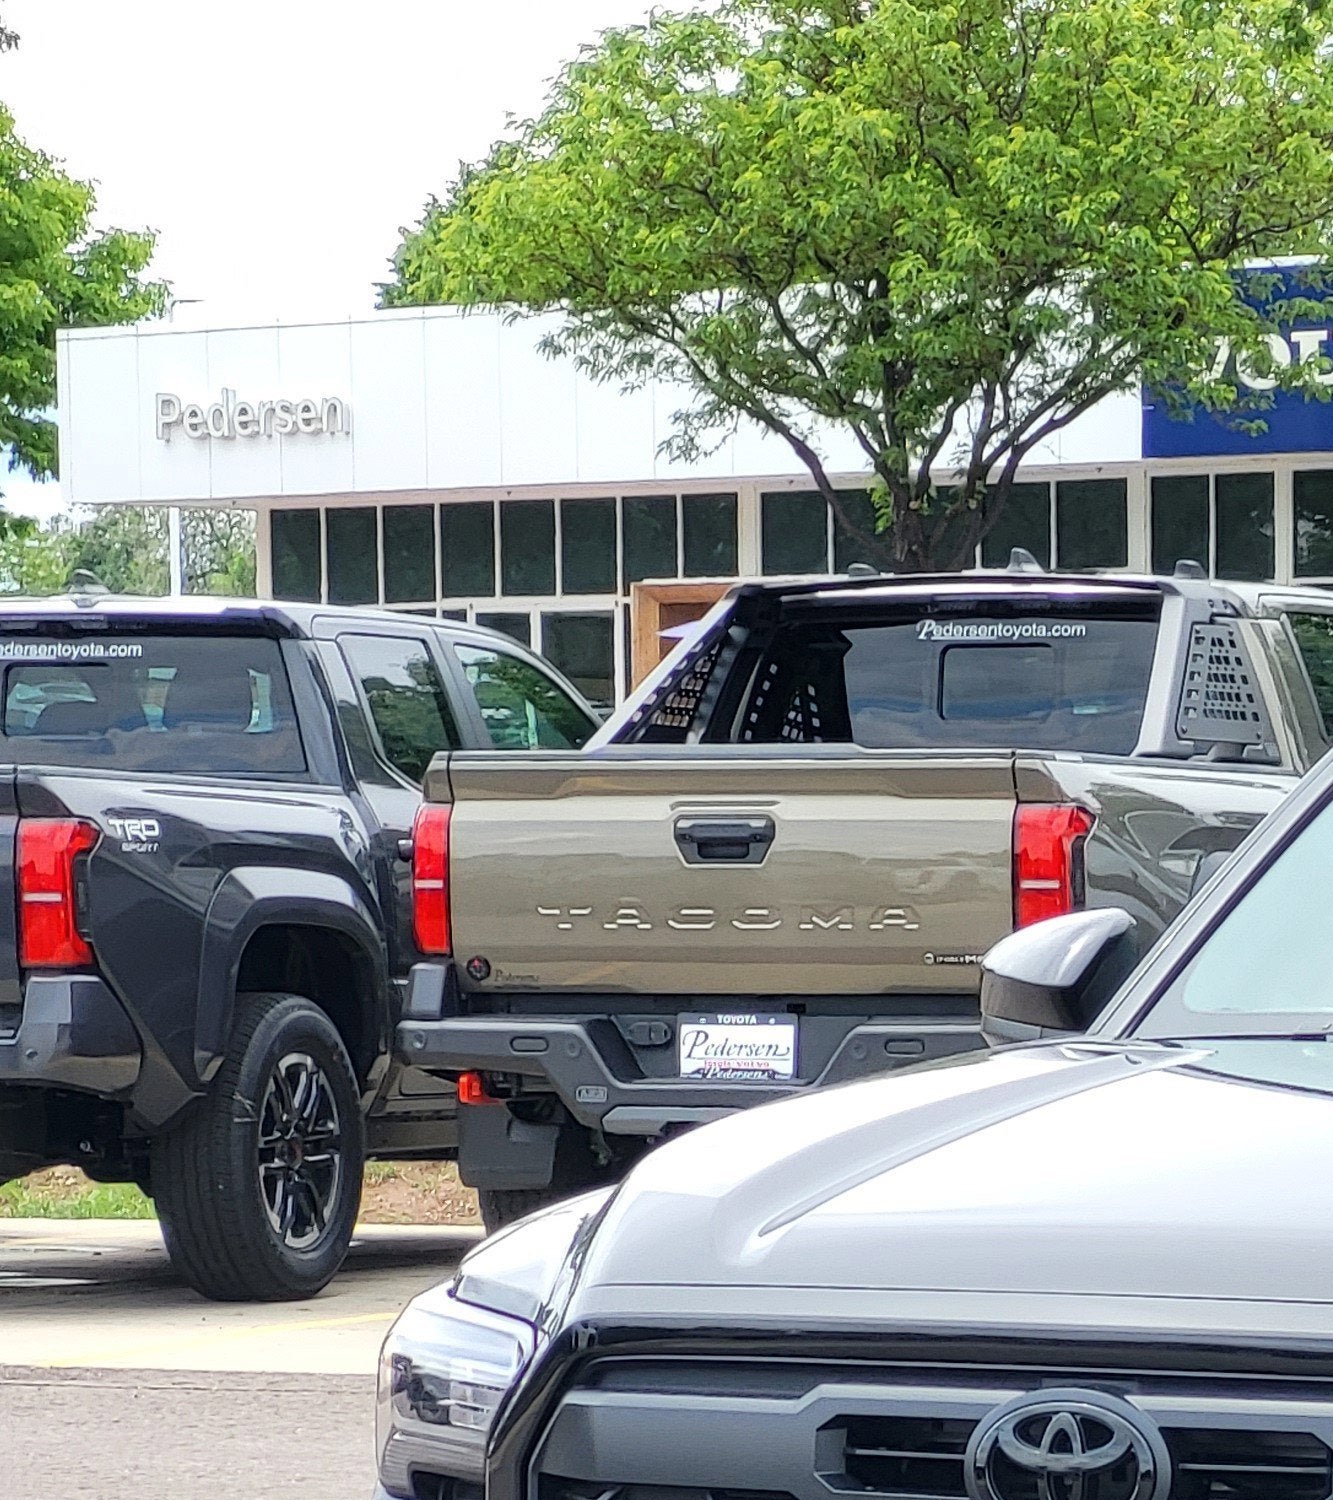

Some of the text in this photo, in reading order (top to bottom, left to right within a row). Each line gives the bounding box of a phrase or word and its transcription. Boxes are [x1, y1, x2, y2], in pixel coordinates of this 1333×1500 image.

[155, 386, 350, 441] Pedersen
[915, 618, 1087, 641] Pedersentoyota.com
[107, 818, 160, 842] TRD
[537, 898, 920, 931] TACOMA
[716, 1014, 757, 1025] TOYOTA
[682, 1029, 791, 1061] Pedersen
